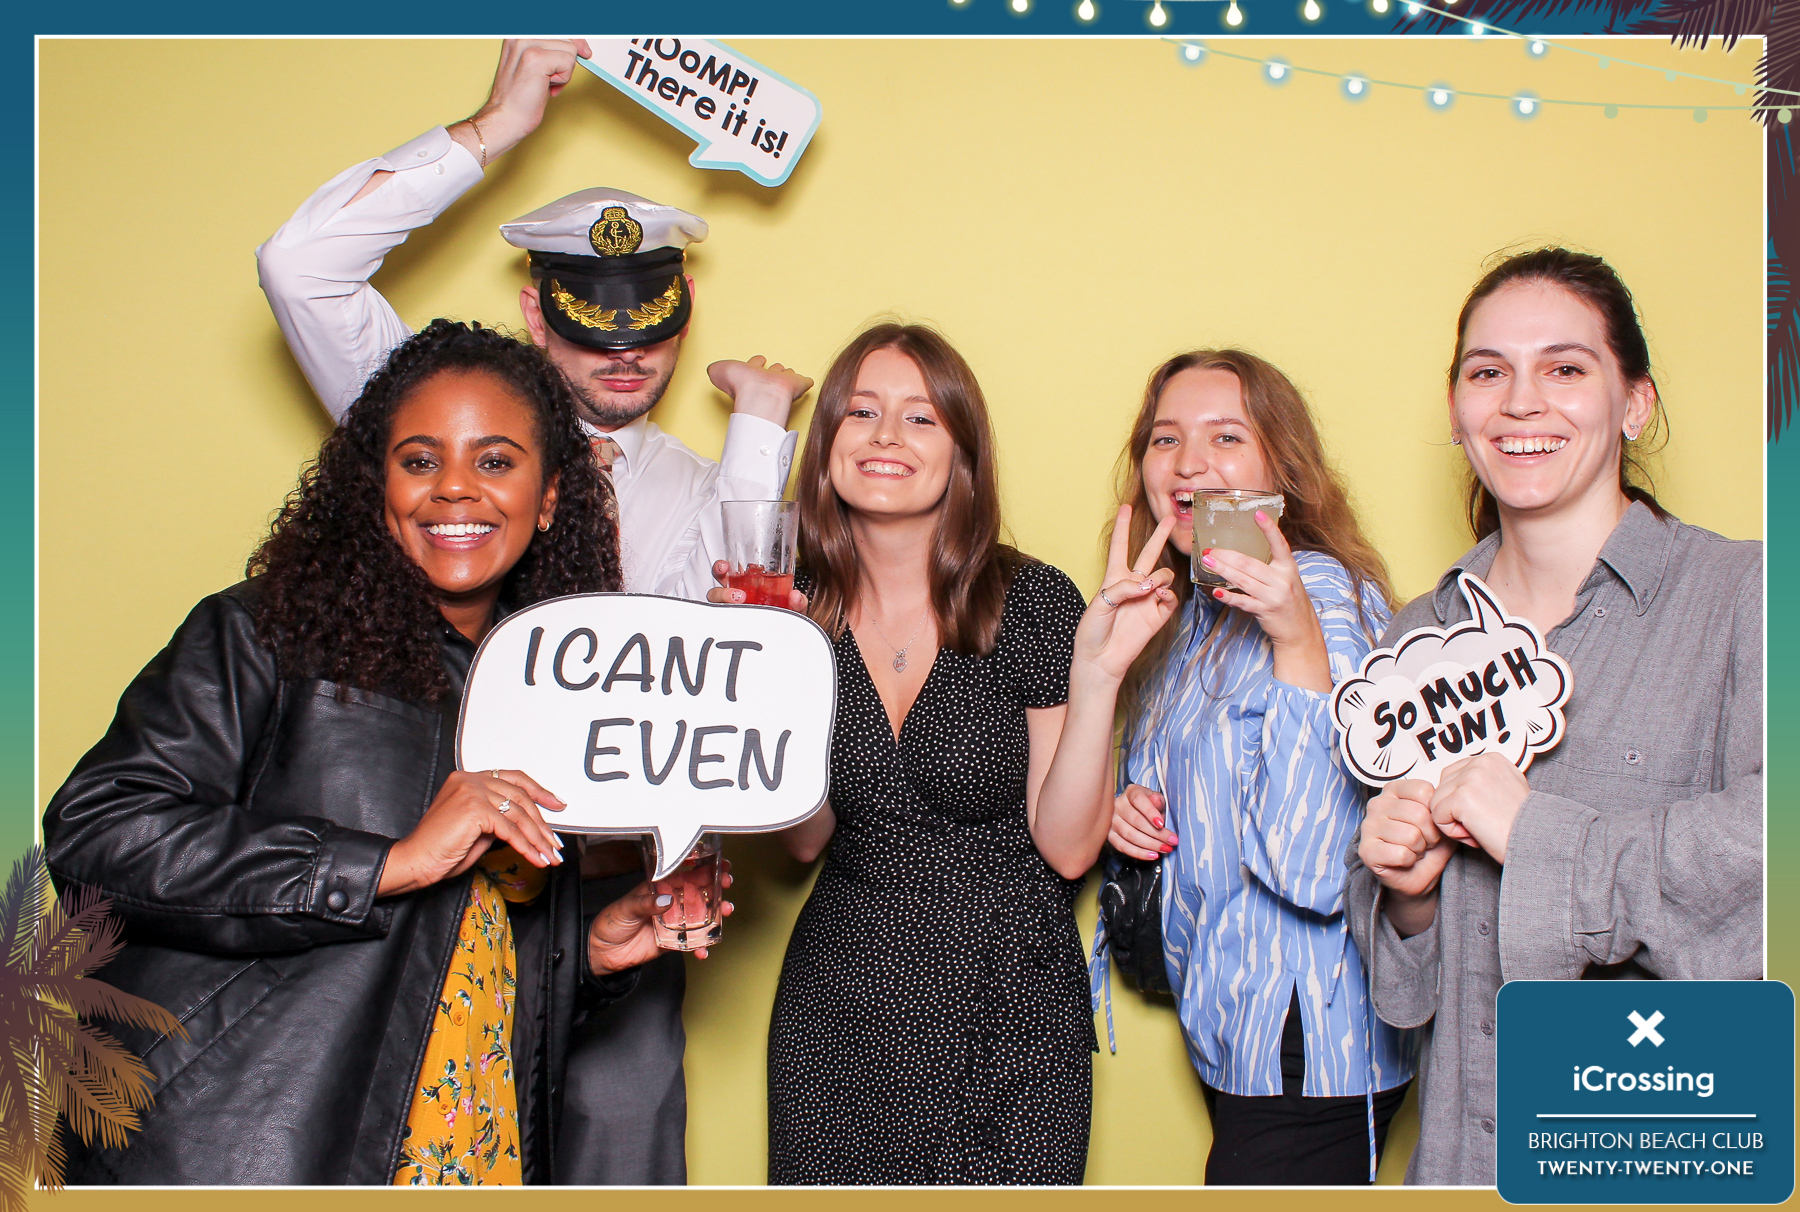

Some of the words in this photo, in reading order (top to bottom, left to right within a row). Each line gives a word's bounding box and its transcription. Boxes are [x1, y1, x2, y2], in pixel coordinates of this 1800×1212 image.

[624, 49, 717, 121] There
[721, 102, 748, 137] it
[750, 118, 790, 159] is!
[524, 626, 545, 687] I
[552, 627, 763, 703] CANT
[1419, 646, 1538, 725] MUCH
[583, 717, 792, 792] EVEN
[1416, 698, 1511, 763] FUN!
